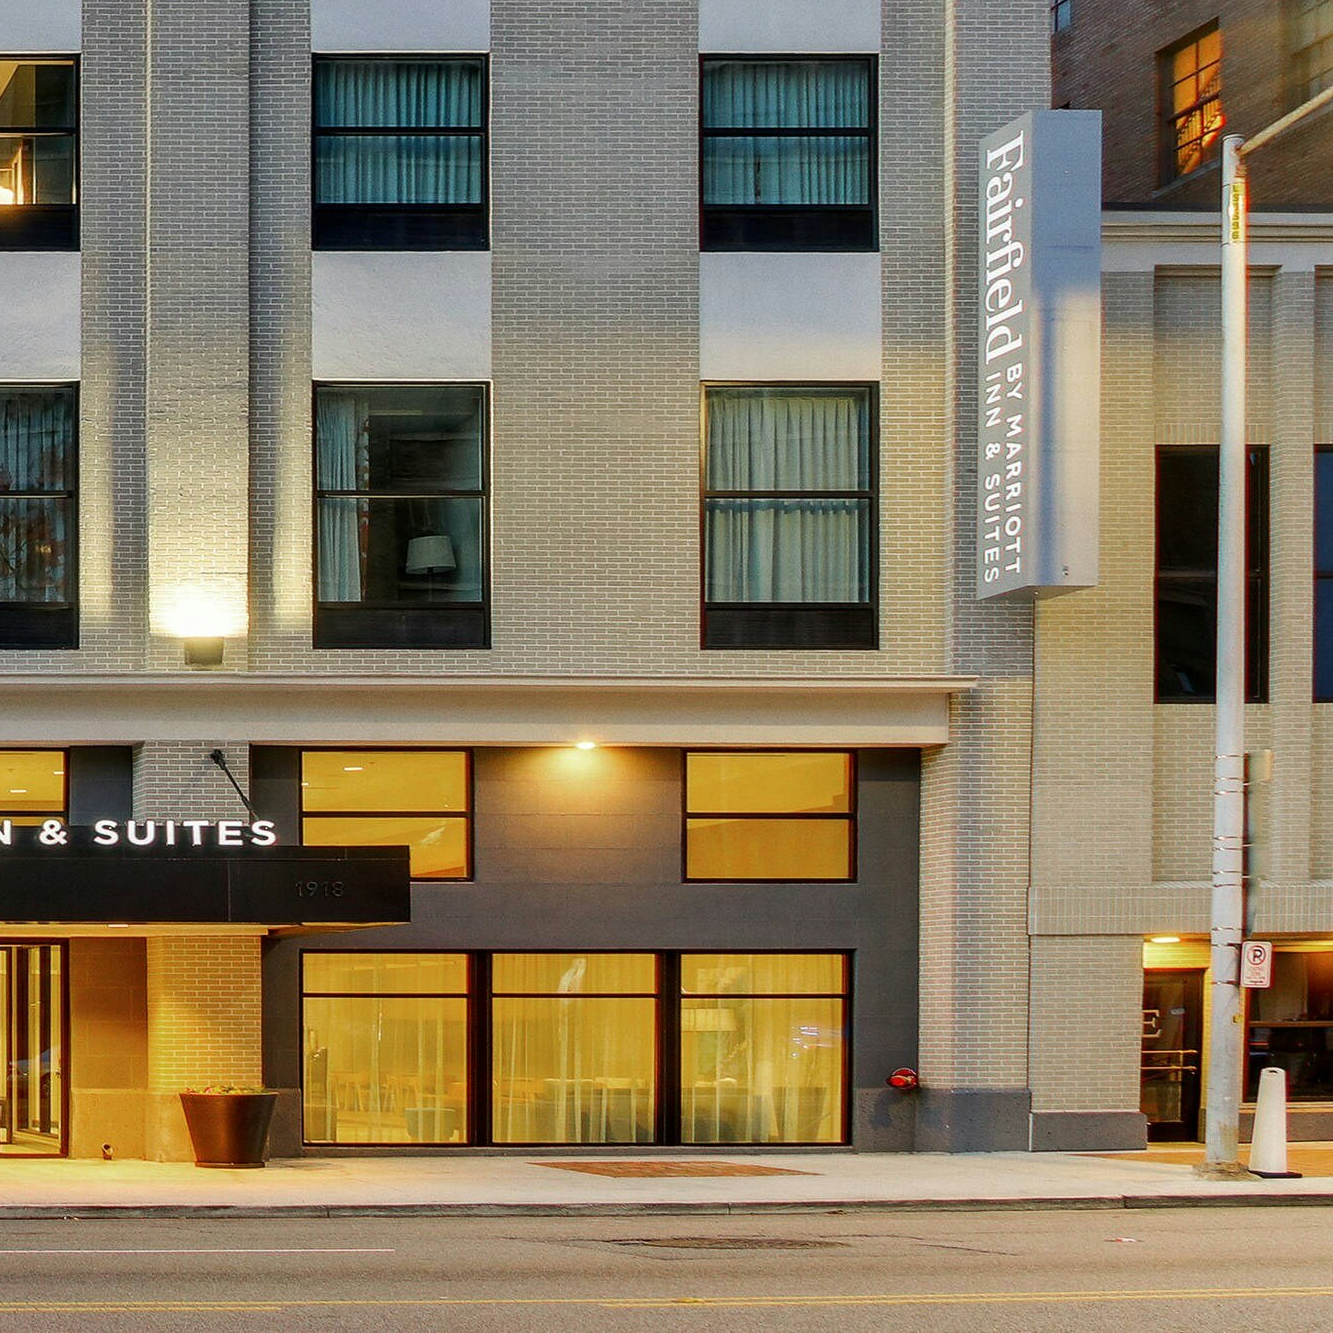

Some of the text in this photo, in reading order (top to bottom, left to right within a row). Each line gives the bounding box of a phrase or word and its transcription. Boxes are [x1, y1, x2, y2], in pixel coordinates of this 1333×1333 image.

[985, 130, 1024, 573] Fairfield BY MARRIOTT
[984, 372, 1001, 583] INN & SUITES
[39, 819, 68, 846] &
[93, 819, 277, 847] SUITES
